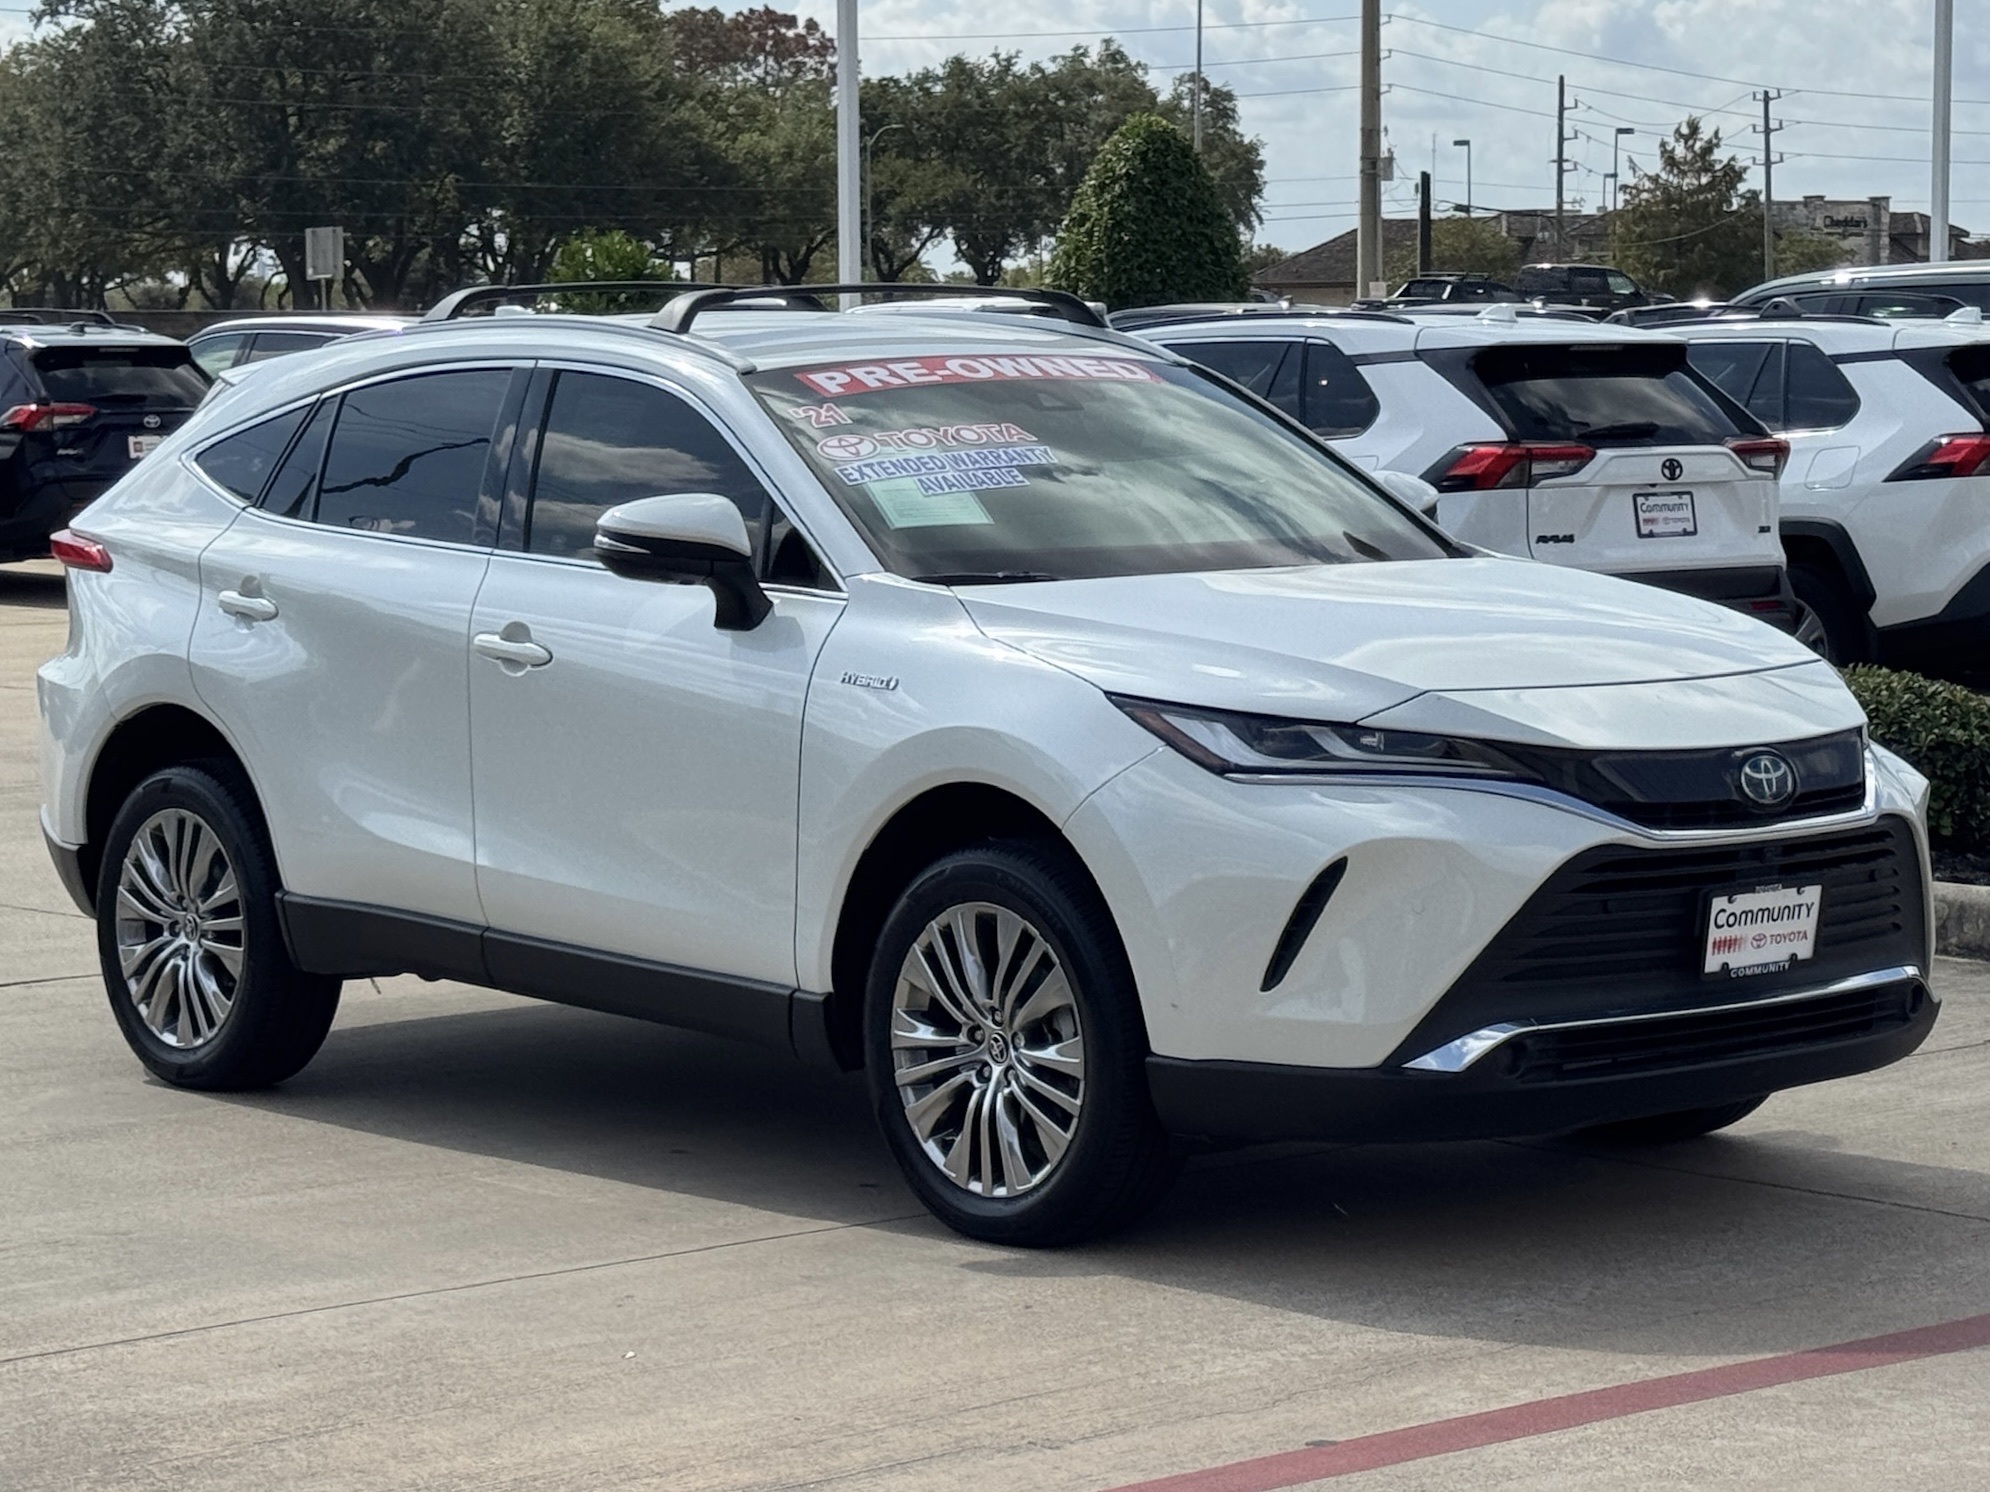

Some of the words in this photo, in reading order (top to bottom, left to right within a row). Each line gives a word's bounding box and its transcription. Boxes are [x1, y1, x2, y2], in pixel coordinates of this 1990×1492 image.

[807, 357, 1150, 394] PRE-OWNED
[788, 403, 853, 429] '21
[875, 423, 1038, 450] TOYOTA
[837, 455, 948, 484] EXTENDED
[946, 448, 1055, 471] WARRANTY
[918, 468, 1026, 495] AVAILABLE
[841, 671, 889, 690] HYBRID
[1769, 930, 1808, 945] TOYOTA
[1730, 960, 1791, 978] COMMUNITY
